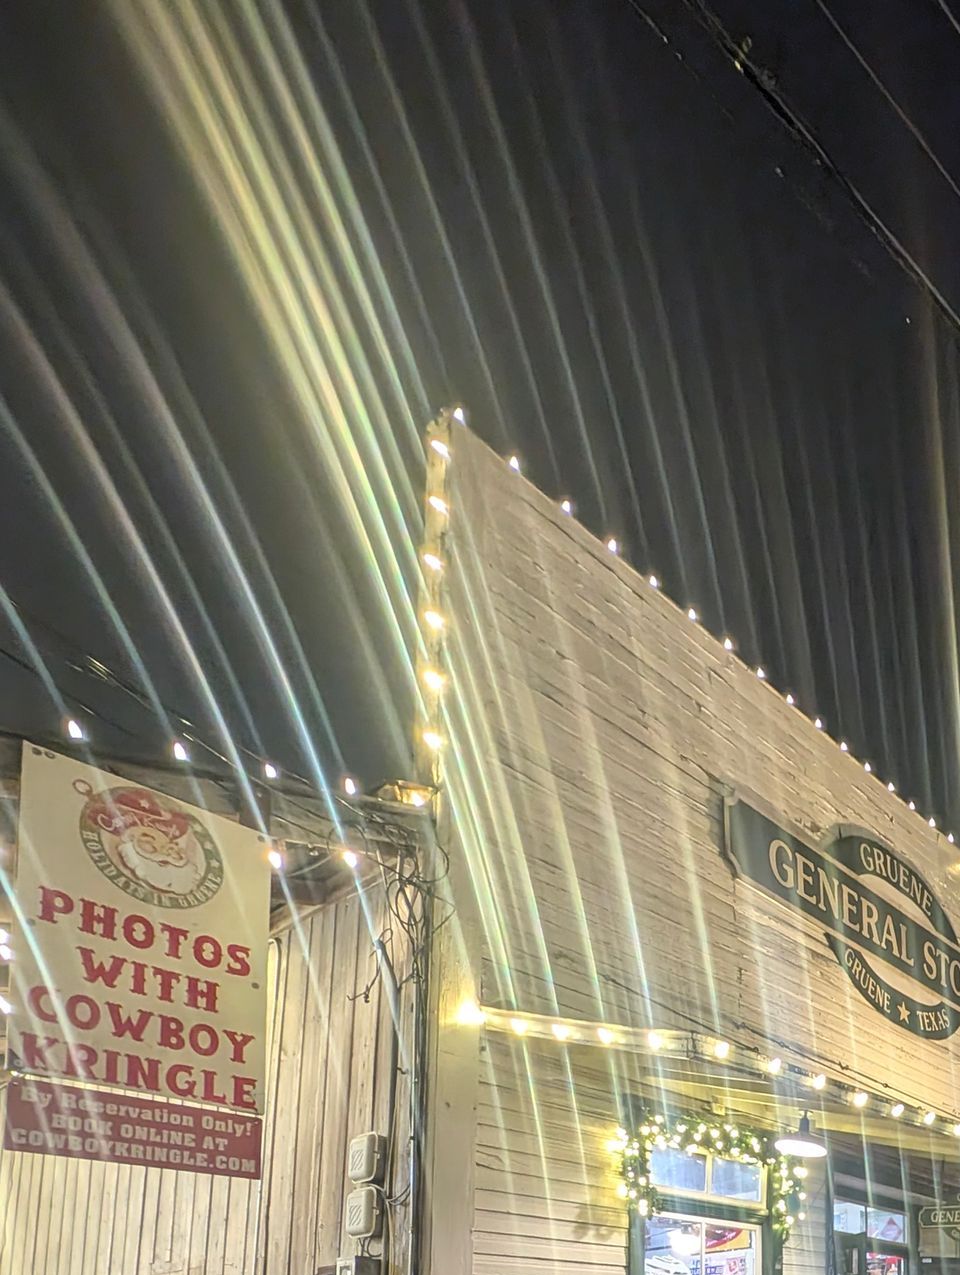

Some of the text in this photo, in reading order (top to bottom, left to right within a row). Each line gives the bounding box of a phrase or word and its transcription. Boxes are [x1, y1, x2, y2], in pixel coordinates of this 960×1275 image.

[82, 830, 147, 899] HOLIDAYS
[860, 842, 934, 917] GRUENE
[37, 886, 252, 977] PHOTOS
[769, 839, 915, 967] GENERAL
[76, 946, 221, 1014] WITH
[844, 948, 951, 1032] GRUENE TEXAS
[28, 985, 256, 1064] COWBOY
[20, 1031, 258, 1112] KRINGLE
[21, 1086, 253, 1137] By Reservation Only!
[52, 1113, 229, 1152] BOOK ONLINE AT
[12, 1127, 257, 1174] COWBOYKRINGLE.COM
